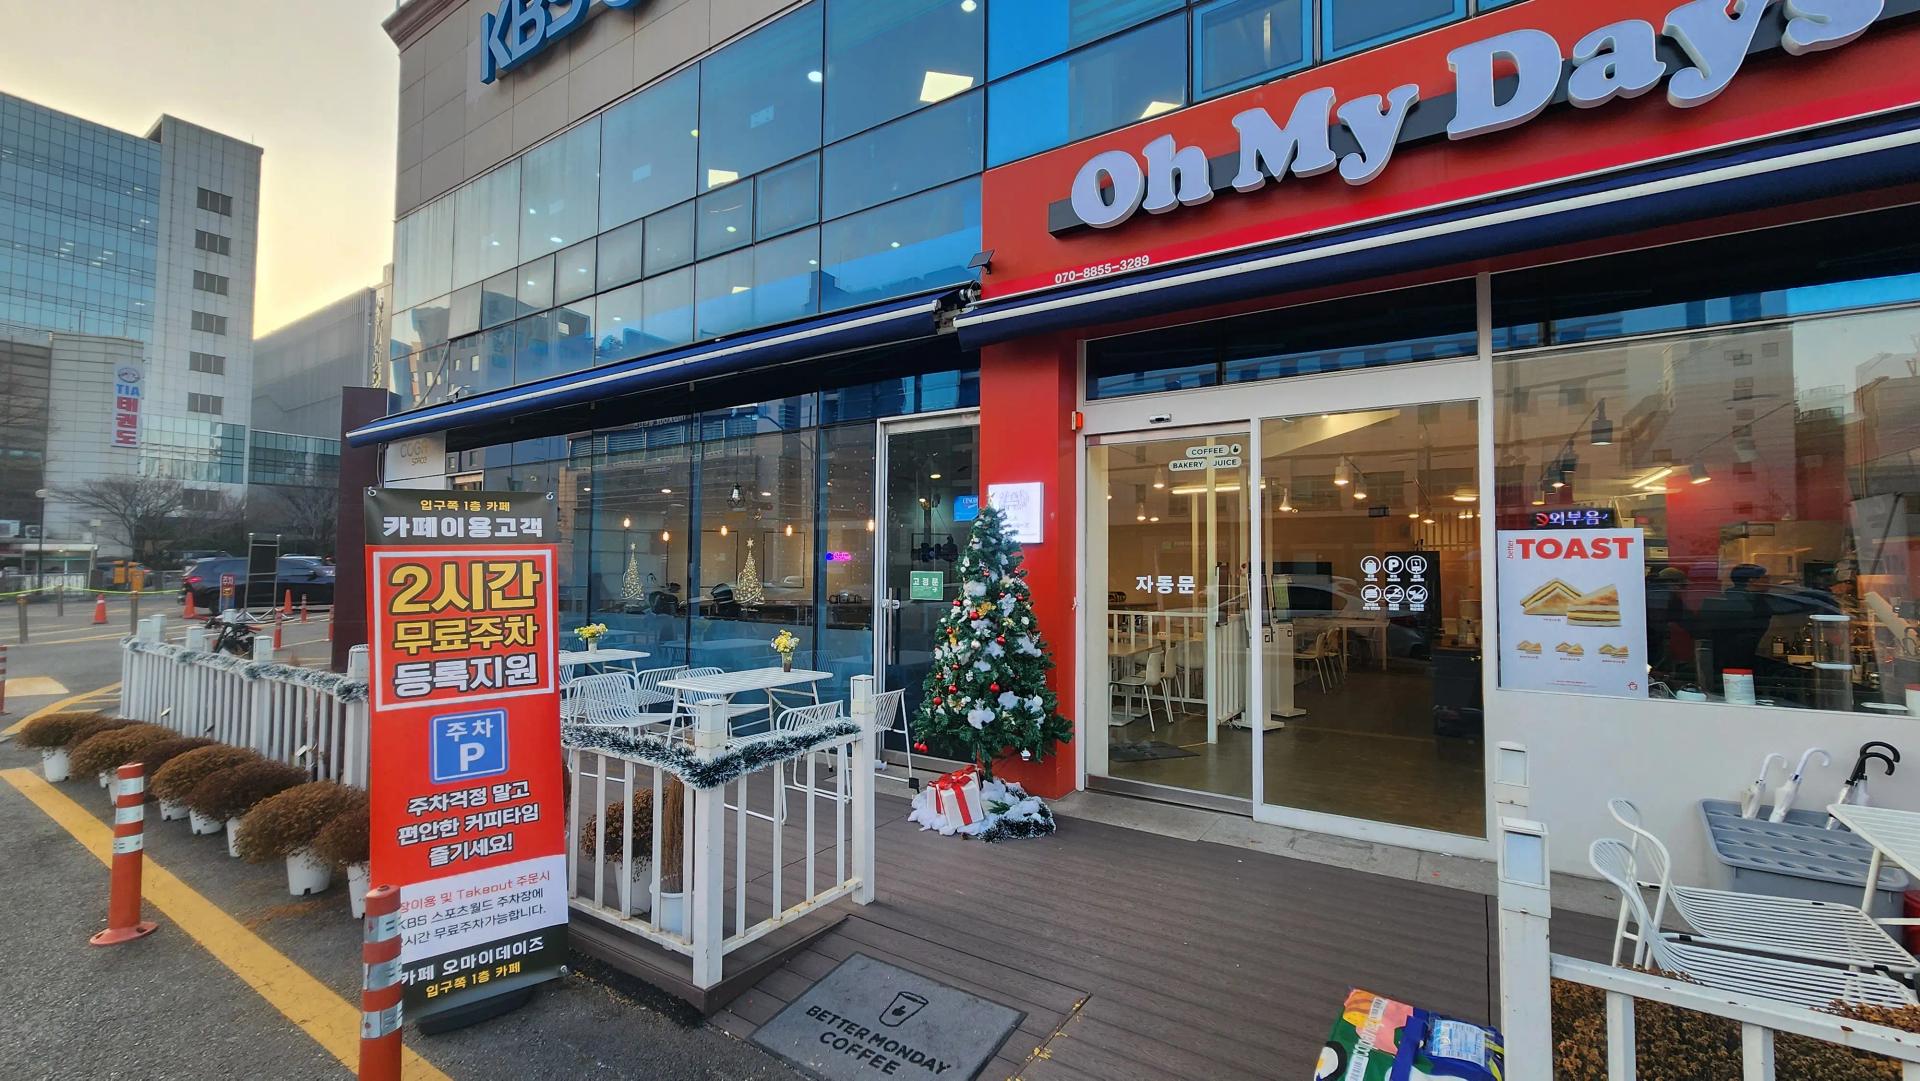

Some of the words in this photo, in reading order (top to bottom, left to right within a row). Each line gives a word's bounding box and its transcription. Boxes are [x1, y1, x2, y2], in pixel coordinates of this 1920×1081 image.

[1071, 134, 1214, 229] Oh
[1231, 84, 1420, 193] My
[1447, 0, 1885, 140] Days
[1054, 255, 1150, 284] 070-8855-3289
[1172, 460, 1204, 469] BAKERY
[1213, 458, 1237, 467] JUICE
[1191, 447, 1224, 456] COFFEE
[420, 499, 460, 512] 입구쪽
[463, 500, 481, 512] 1층
[486, 500, 511, 513] 카페
[1549, 510, 1608, 526] 외부음
[383, 516, 543, 538] 카페이용고객
[1516, 538, 1634, 560] TOAST
[390, 561, 542, 614] 2시간
[1135, 575, 1196, 594] 자동문
[394, 614, 539, 654] 무료주차
[394, 653, 538, 697] 등록지원
[446, 718, 494, 742] 주차
[459, 742, 486, 772] P
[407, 787, 488, 816] 주차걱정
[492, 780, 531, 803] 말고
[397, 817, 460, 846] 편안한
[464, 803, 540, 832] 커피타임
[428, 832, 514, 867] 즐기세요!
[440, 892, 453, 905] 및
[456, 880, 513, 899] Takeout
[516, 870, 551, 887] 주문시
[431, 900, 494, 924] 스포츠월드
[497, 888, 544, 908] 주차장에
[401, 931, 431, 948] 시간
[434, 904, 546, 939] 무료주차가능합니다.
[401, 964, 434, 986] 카페
[441, 936, 544, 976] 오마이데이즈
[425, 976, 467, 998] 입구쪽
[472, 970, 490, 985] 1층
[496, 961, 521, 978] 카페
[805, 1005, 870, 1040] BETTER
[867, 1033, 951, 1075] MONDAY
[819, 1031, 901, 1076] COFFEE
